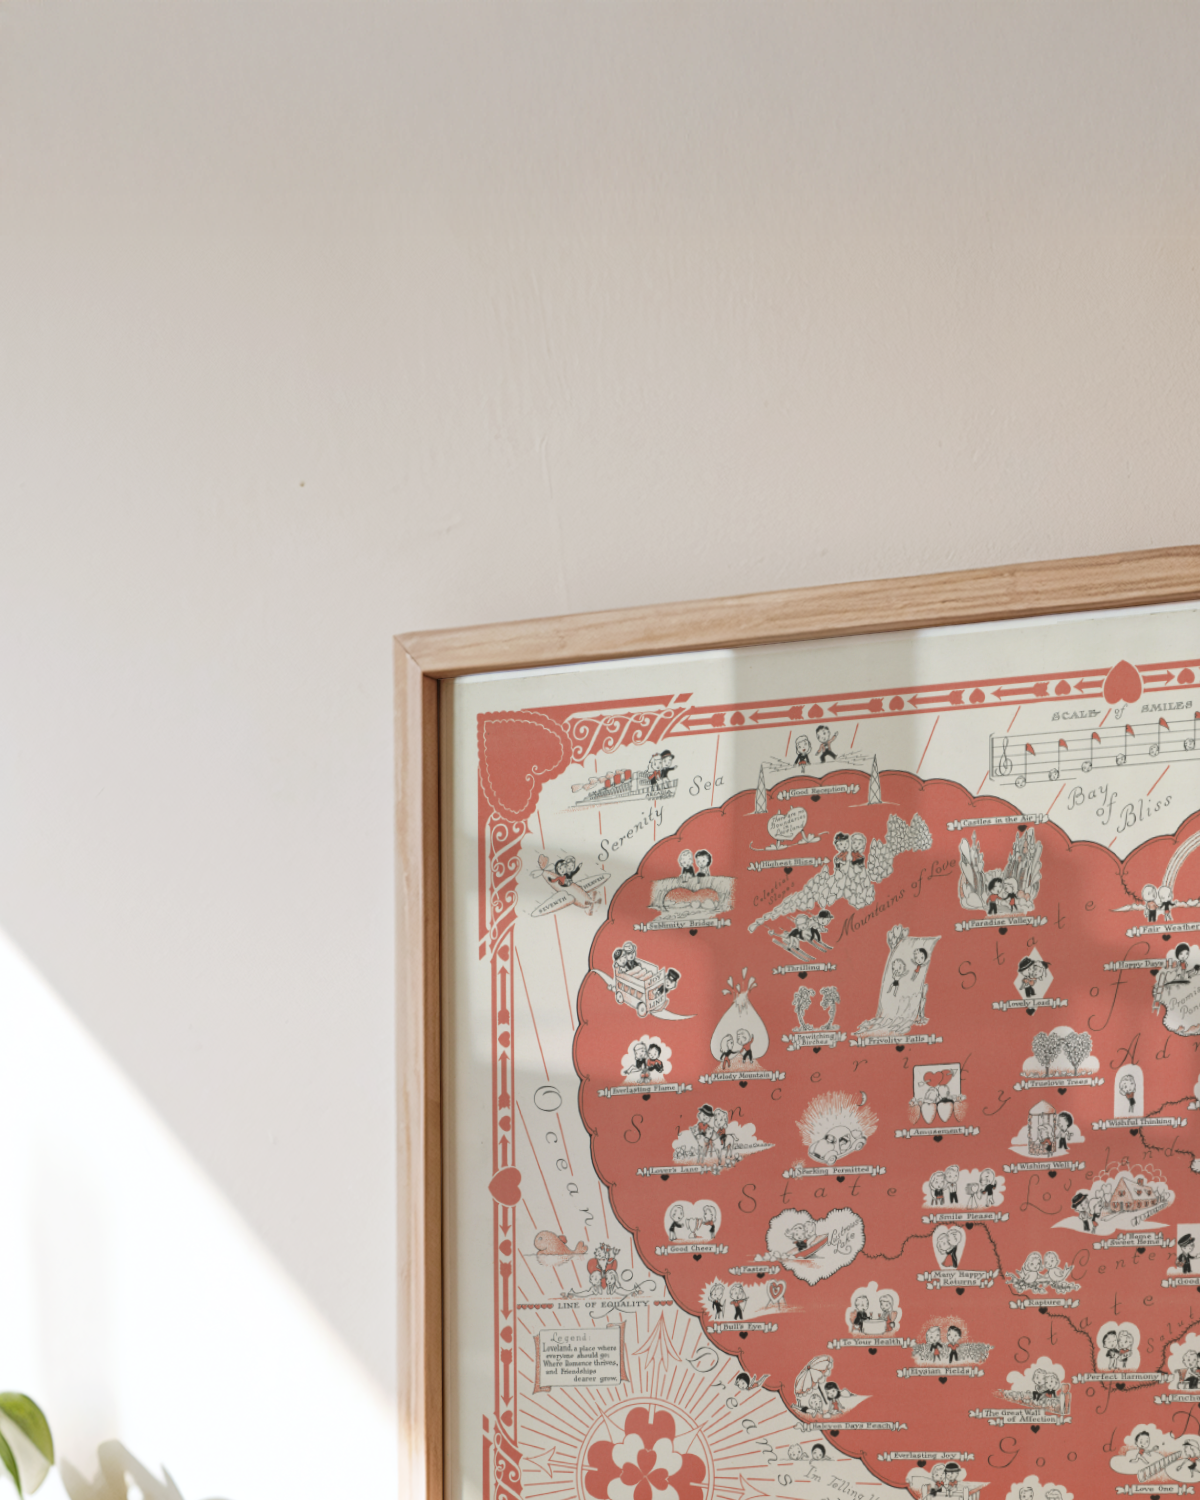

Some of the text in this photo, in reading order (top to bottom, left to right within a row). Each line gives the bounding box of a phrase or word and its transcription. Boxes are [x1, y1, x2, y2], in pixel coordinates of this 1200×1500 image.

[1114, 703, 1129, 720] of
[1140, 700, 1193, 714] SMILES
[688, 774, 725, 797] Sea
[790, 785, 846, 797] Good Reception
[1066, 783, 1109, 811] Bay
[1095, 791, 1118, 825] of
[1116, 795, 1173, 834] Bliss
[597, 805, 664, 862] Serenity
[538, 896, 568, 914] SEVENTH
[836, 858, 957, 943] Mountains of Love
[969, 916, 1034, 928] Paradise Valley
[1141, 921, 1200, 935] Fair Weather
[785, 963, 821, 973] Thrilling
[1117, 959, 1165, 970] Happy Days
[712, 1070, 771, 1082] Melody Mountain
[1029, 1077, 1089, 1088] Truelove Trees
[612, 1083, 677, 1095] Everlasting Flame
[1107, 1117, 1172, 1128] Wishful Thinking
[912, 1126, 963, 1136] Amusement
[533, 1084, 595, 1227] Ocean
[1019, 1159, 1071, 1171] Wishing Well
[938, 1211, 993, 1222] Smile Please
[670, 1243, 714, 1253] Good Cheer
[742, 1265, 768, 1274] Faster
[933, 1270, 986, 1281] Many Happy
[1176, 1276, 1200, 1286] Good
[942, 1277, 977, 1287] Returns
[600, 1300, 650, 1309] EQUALITY
[1027, 1299, 1063, 1309] Rapture
[579, 1345, 596, 1354] place
[597, 1344, 617, 1352] where
[542, 1359, 563, 1367] Where
[565, 1359, 593, 1367] Romance
[560, 1367, 597, 1376] Friendships
[908, 1366, 970, 1377] Elysian Fields
[573, 1374, 618, 1384] dearer grow.
[1085, 1372, 1160, 1383] Perfect Harmony
